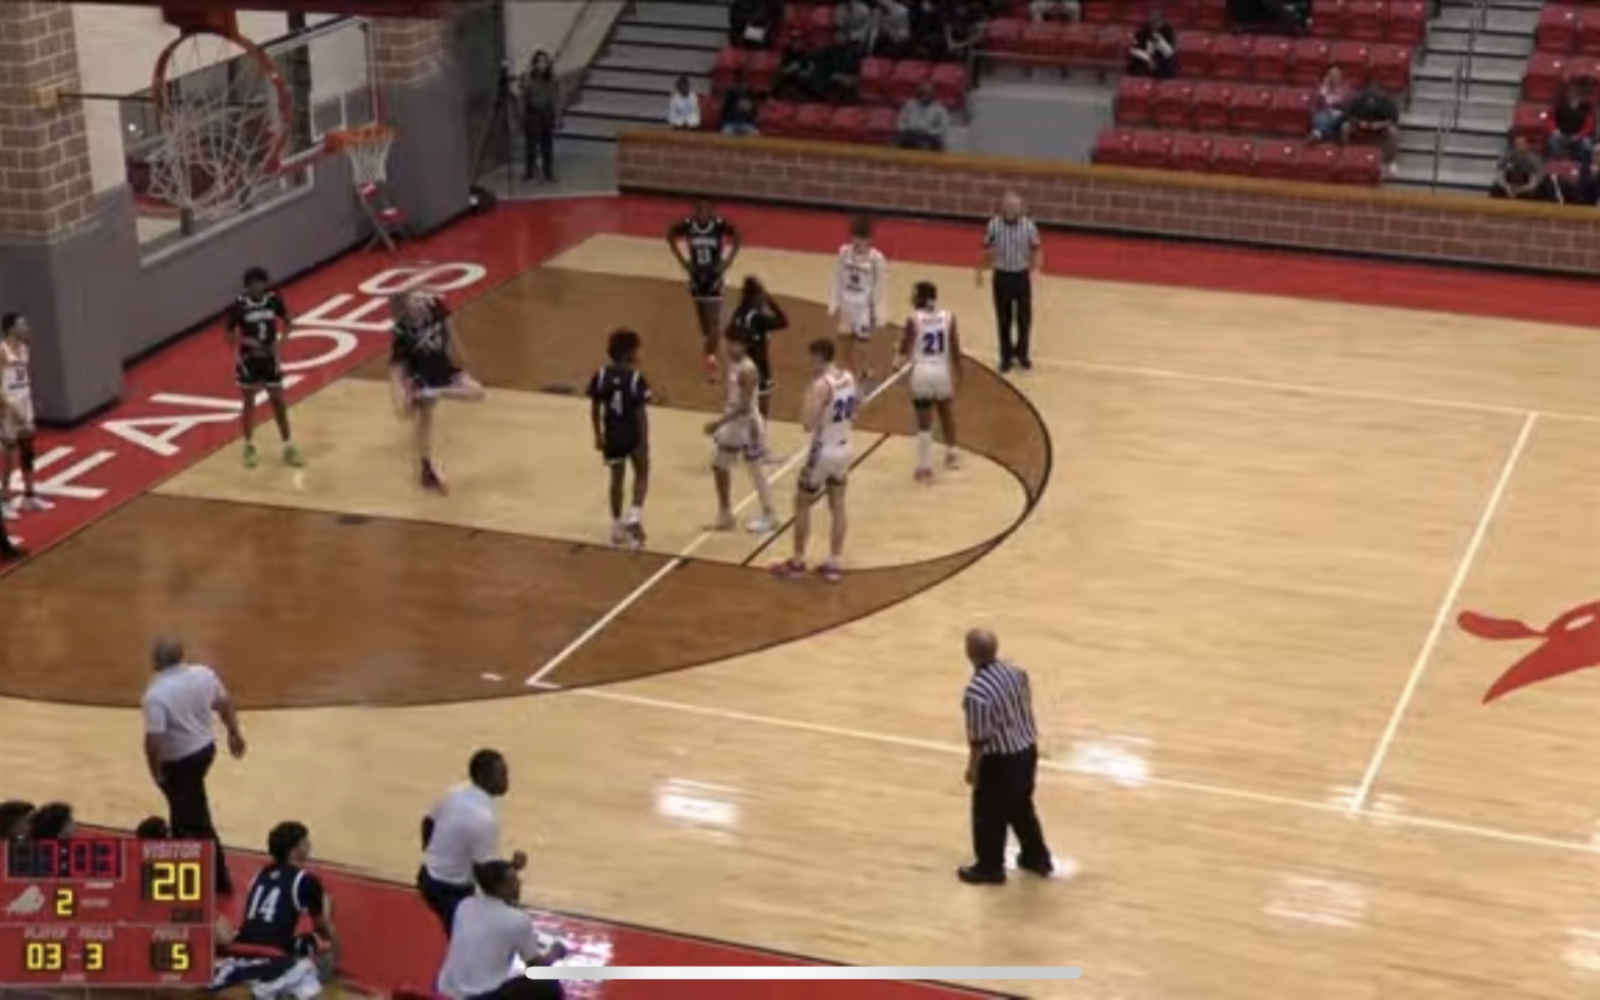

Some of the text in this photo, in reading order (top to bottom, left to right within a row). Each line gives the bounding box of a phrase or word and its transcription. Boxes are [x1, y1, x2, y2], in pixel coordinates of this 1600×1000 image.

[922, 329, 945, 356] 21
[610, 389, 624, 417] 4
[246, 883, 281, 923] 14
